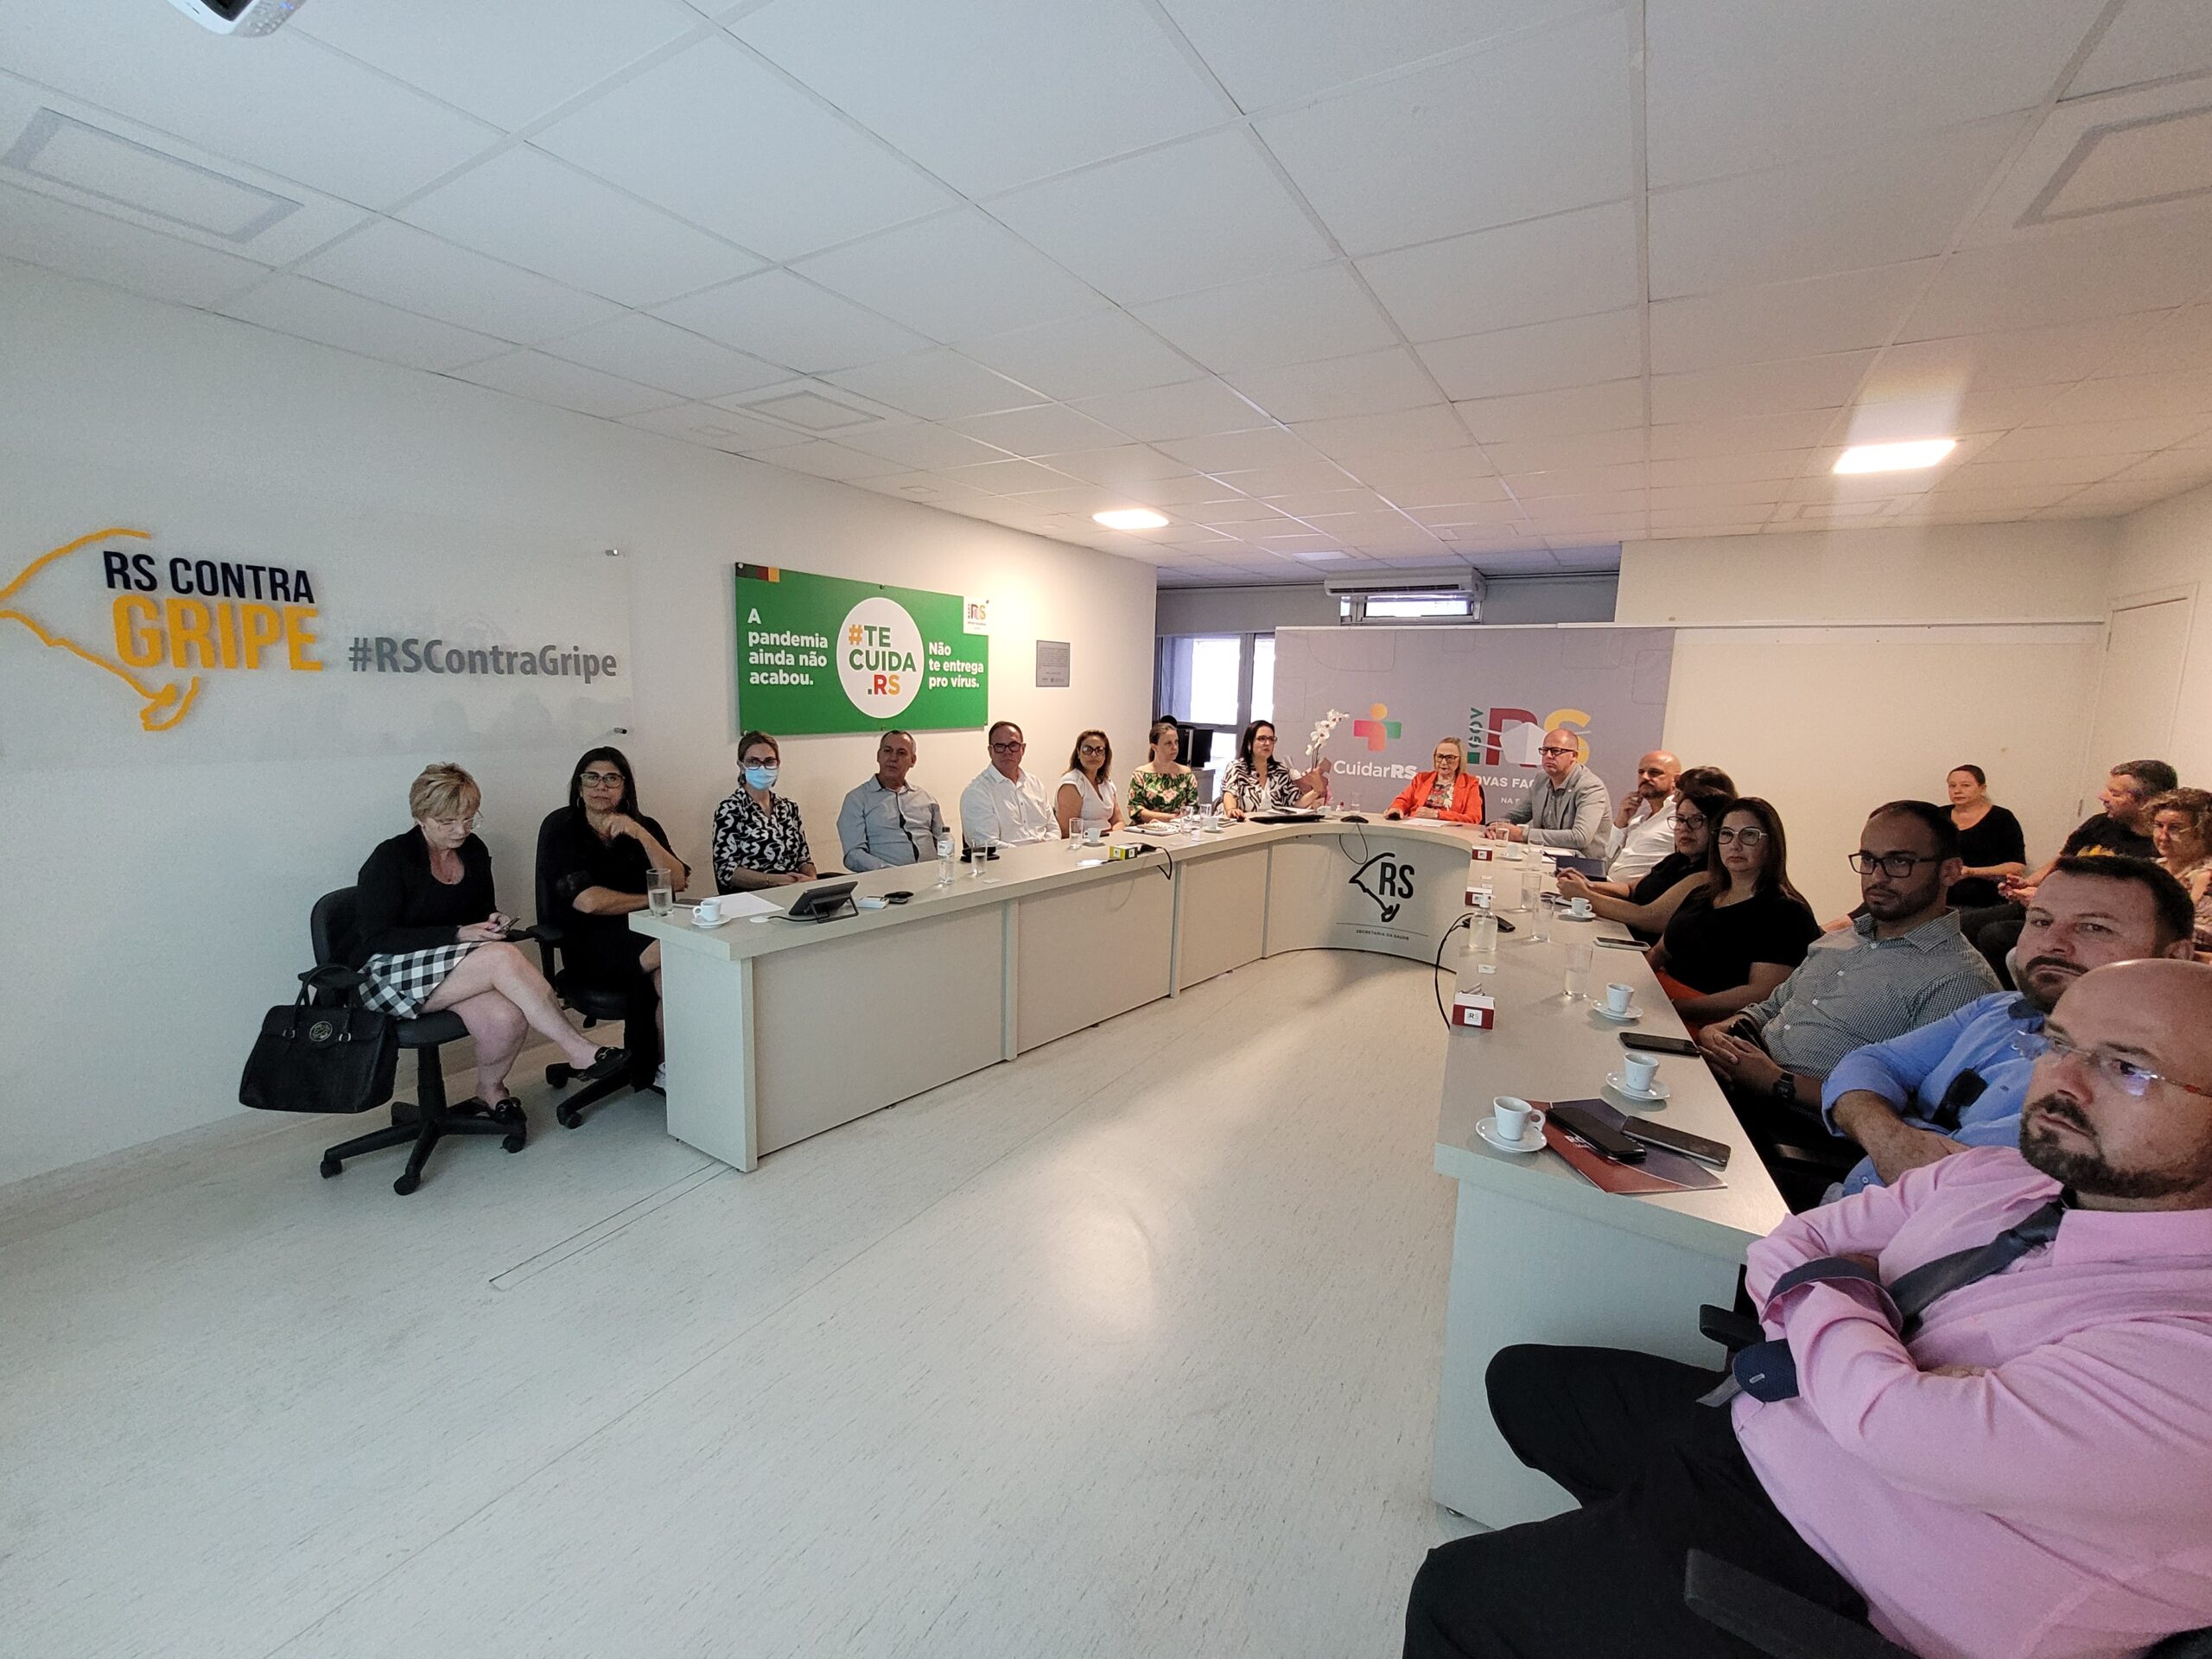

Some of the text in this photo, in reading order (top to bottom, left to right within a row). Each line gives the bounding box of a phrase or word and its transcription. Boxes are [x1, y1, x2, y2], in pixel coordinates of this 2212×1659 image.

[103, 550, 315, 604] RS CONTRA
[747, 607, 762, 625] A
[112, 594, 323, 671] GRIPE
[748, 630, 829, 649] pandemia
[849, 624, 892, 648] #TE
[748, 648, 828, 667] ainda não
[929, 642, 951, 657] Não
[348, 637, 617, 684] #RSContraGripe
[849, 648, 917, 672] CUIDA
[929, 658, 984, 675] te entrega
[749, 669, 814, 685] acabou.
[868, 674, 900, 696] .RS
[929, 675, 980, 690] pro vírus.
[1333, 760, 1417, 780] CuidarRS
[1379, 861, 1414, 899] RS
